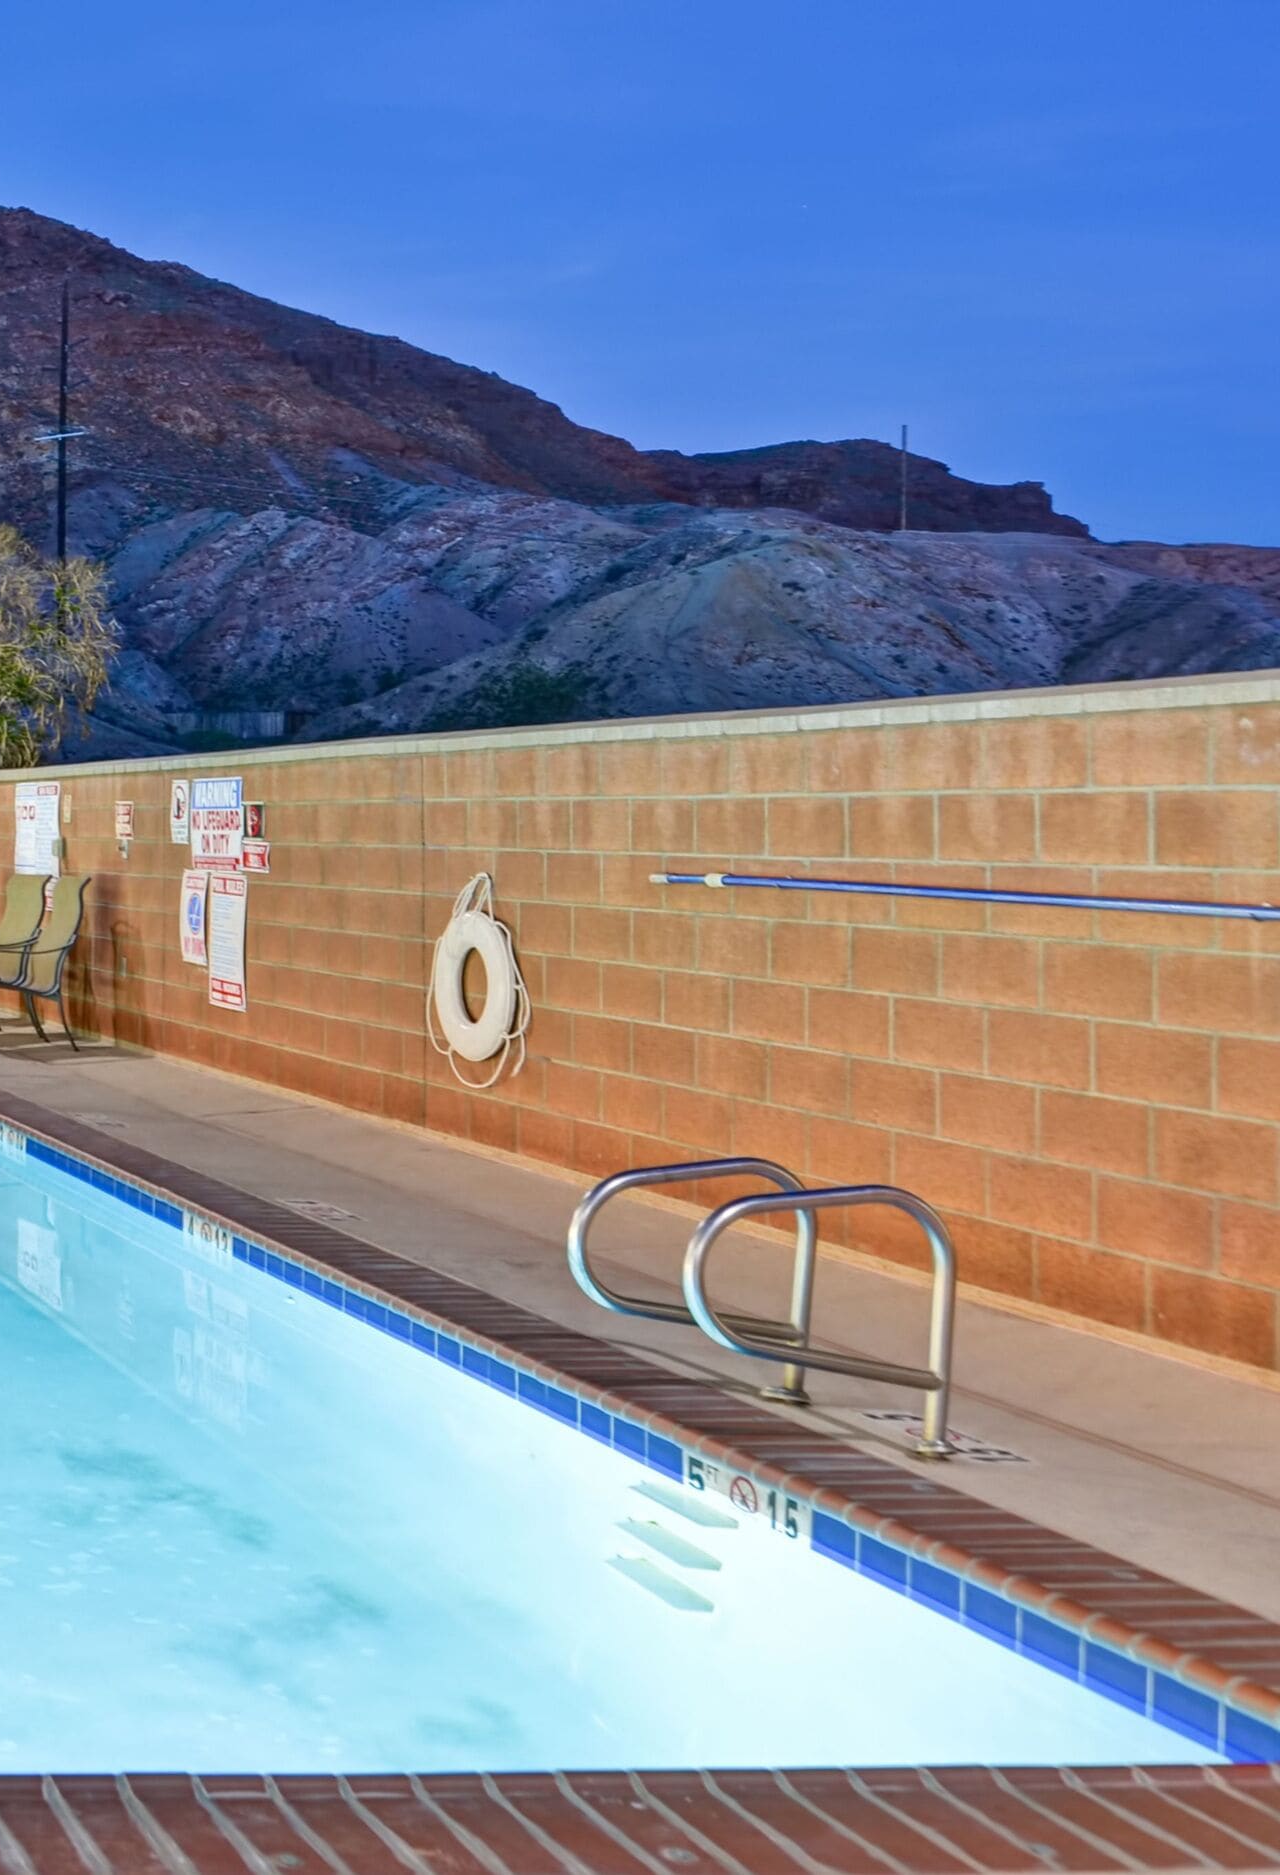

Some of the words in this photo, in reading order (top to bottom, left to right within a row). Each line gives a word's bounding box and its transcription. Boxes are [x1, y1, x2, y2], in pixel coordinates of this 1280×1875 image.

[194, 781, 238, 808] WARNING
[203, 810, 240, 830] LIFEGUARD
[689, 1456, 705, 1491] 5
